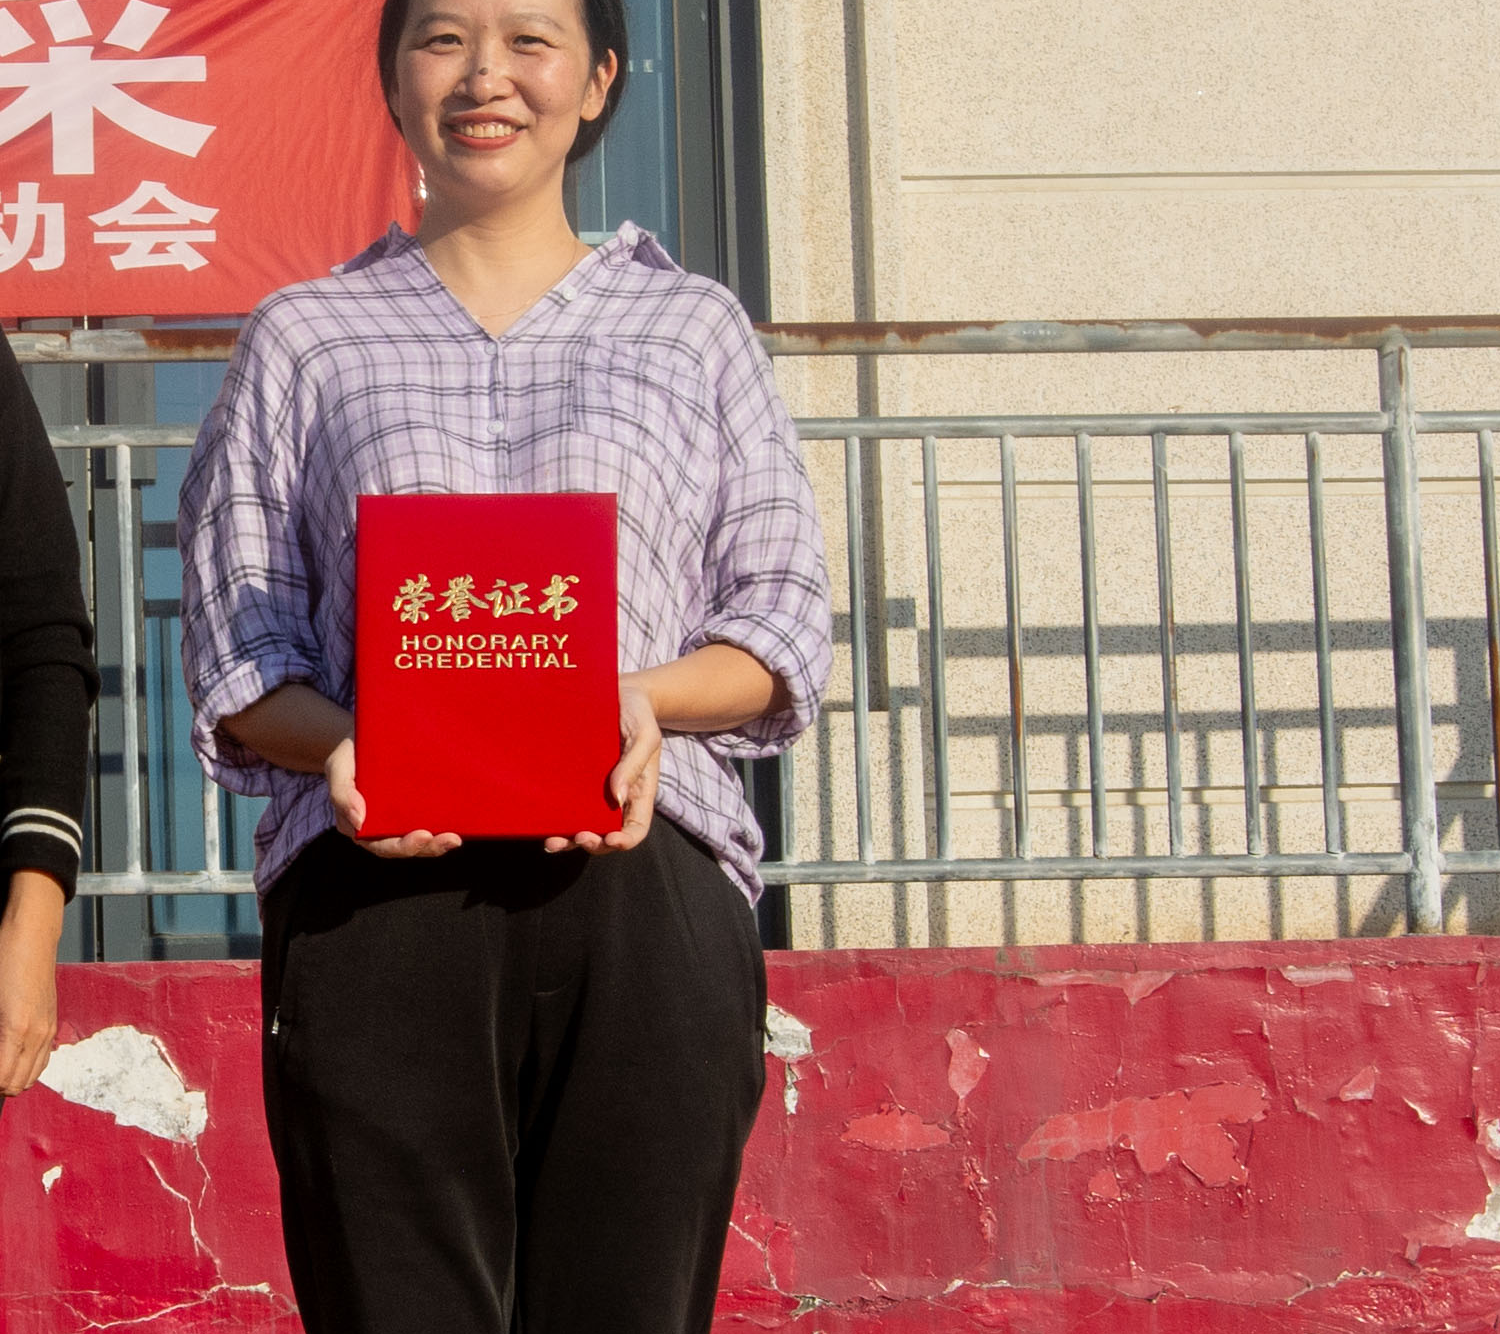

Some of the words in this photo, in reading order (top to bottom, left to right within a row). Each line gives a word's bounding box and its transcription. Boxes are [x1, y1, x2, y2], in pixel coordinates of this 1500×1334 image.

[392, 573, 580, 625] 荣誉证书
[401, 634, 569, 651] HONORARY
[394, 652, 578, 670] CREDENTIAL
